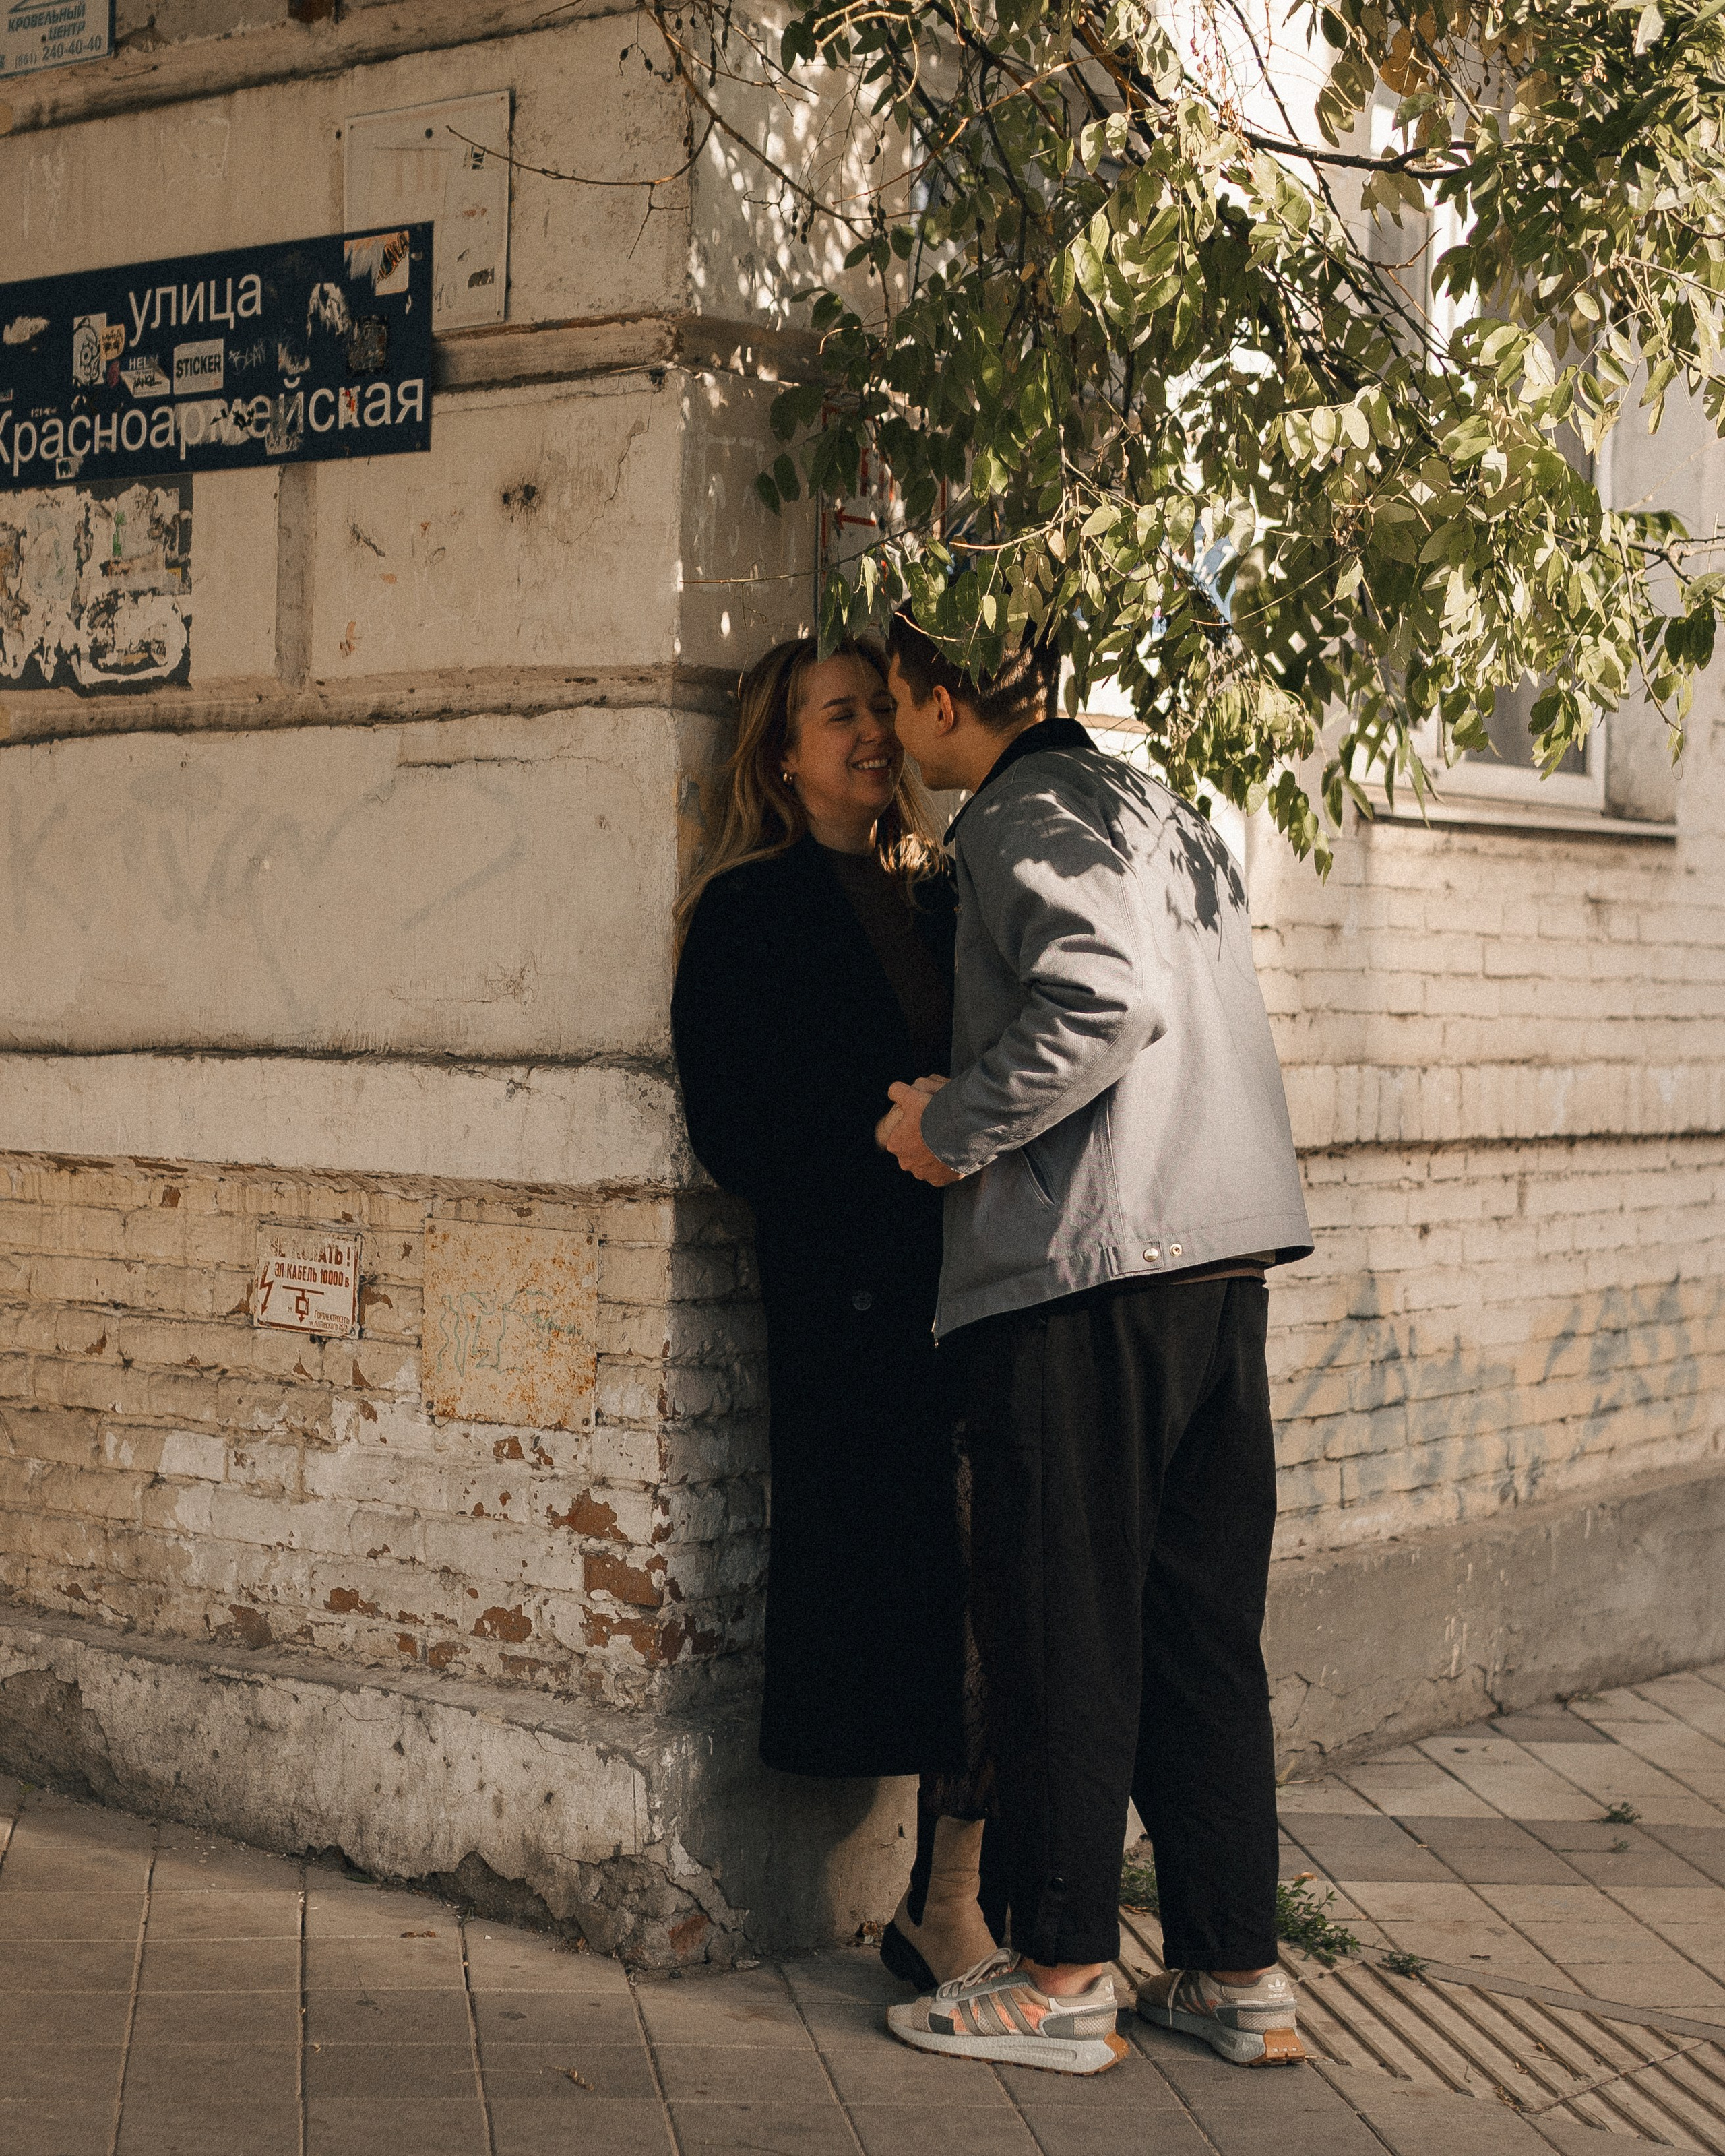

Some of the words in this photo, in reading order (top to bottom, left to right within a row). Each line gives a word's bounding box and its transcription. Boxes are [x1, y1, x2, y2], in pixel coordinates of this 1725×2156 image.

[8, 2, 86, 32] КРОВЕЛЬНЫЙ
[49, 20, 86, 41] ЦЕНТР
[42, 34, 102, 61] 240-40-40
[129, 274, 262, 346] улица
[175, 354, 222, 378] STICKER
[286, 1263, 317, 1283] КАБЕЛЬ
[320, 1268, 344, 1287] 10000
